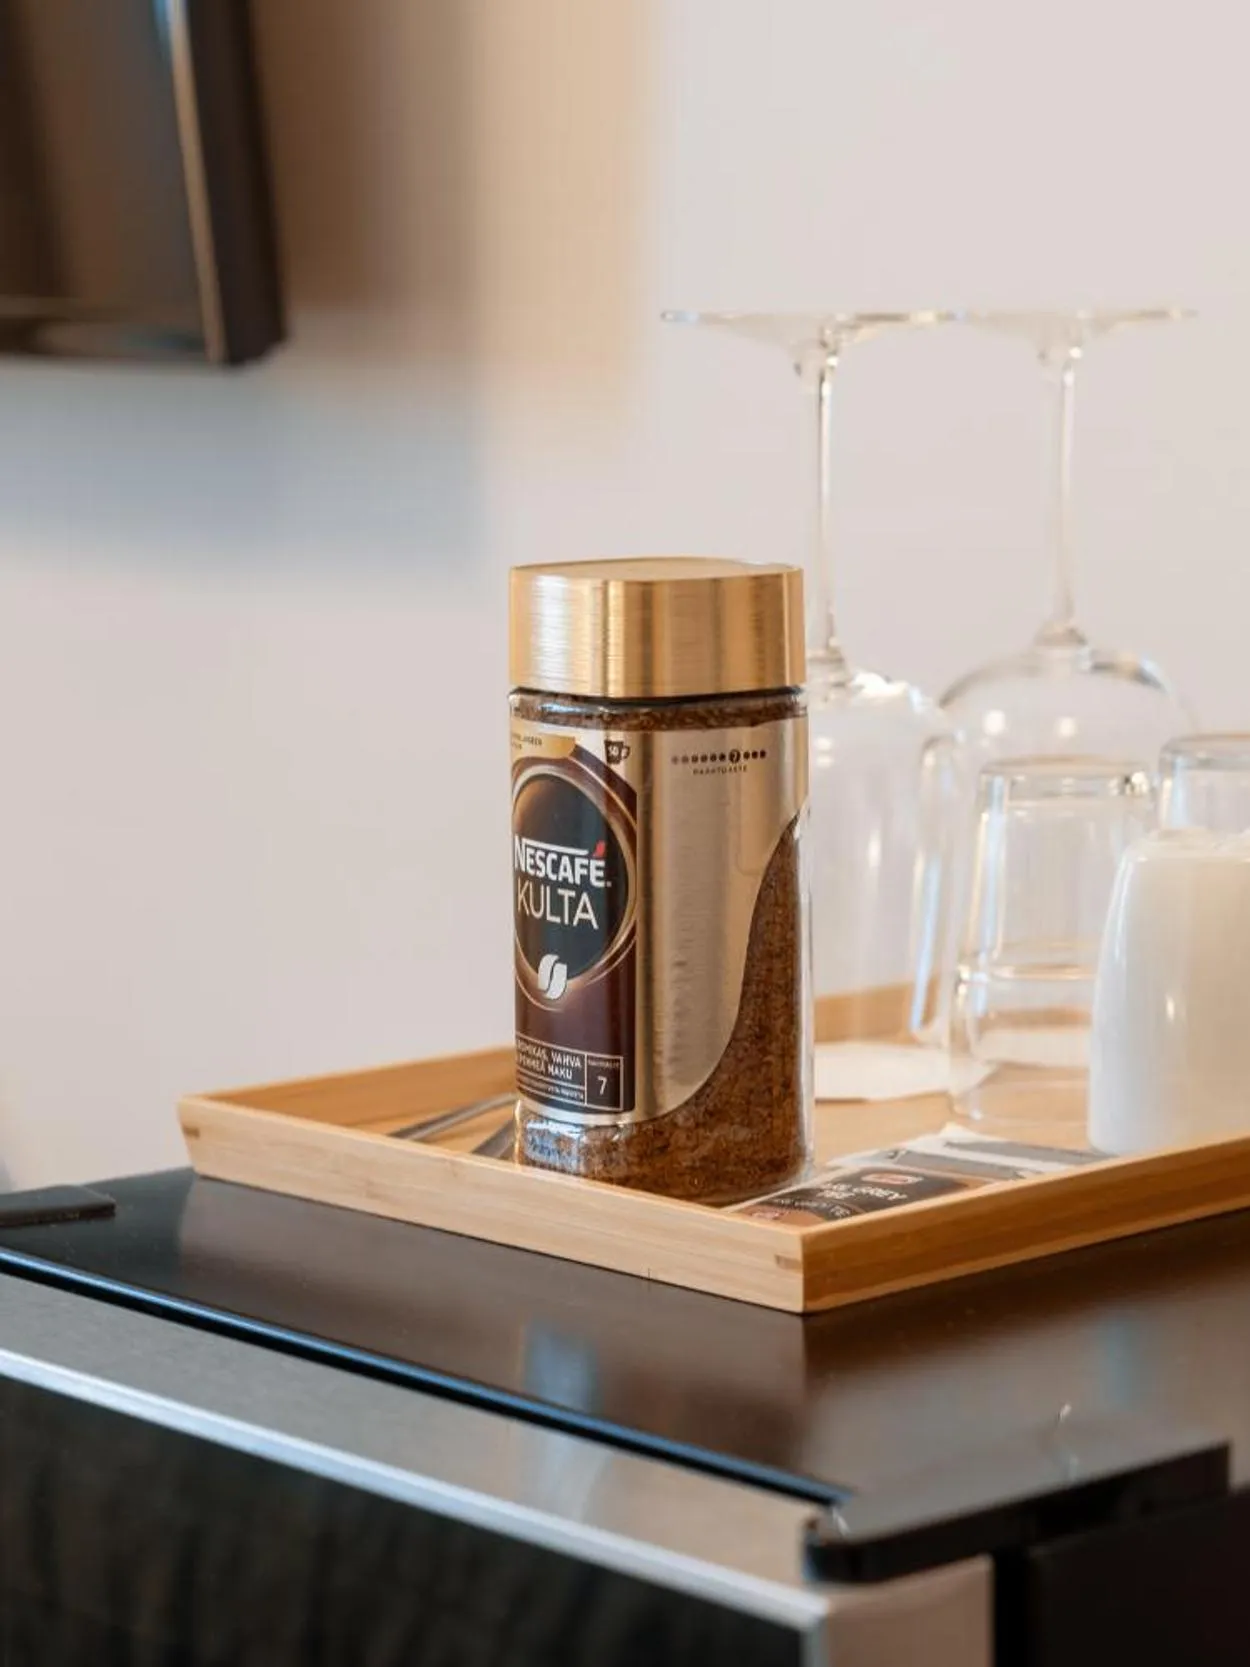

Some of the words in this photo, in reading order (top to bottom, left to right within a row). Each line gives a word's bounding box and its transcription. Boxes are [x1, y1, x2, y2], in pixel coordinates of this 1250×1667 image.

[517, 876, 599, 930] KULTA
[551, 1050, 582, 1068] VAHVA
[548, 1064, 573, 1080] MAKU
[597, 1076, 607, 1095] 7
